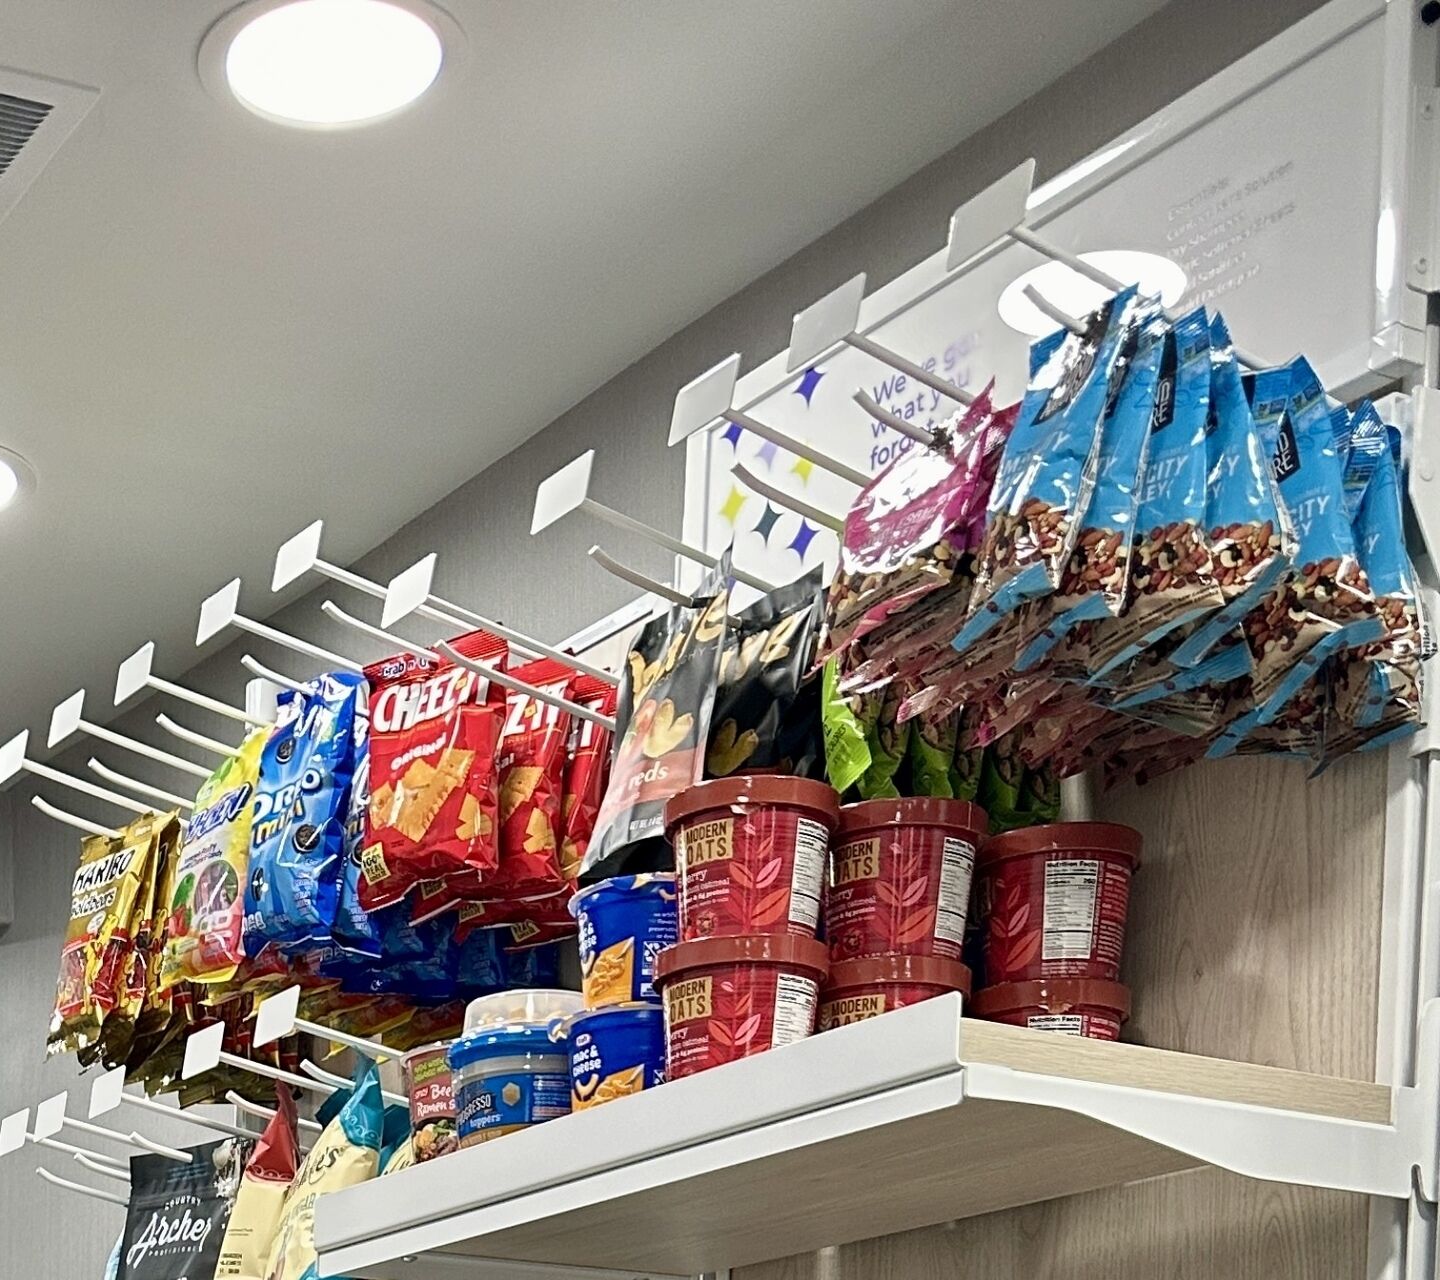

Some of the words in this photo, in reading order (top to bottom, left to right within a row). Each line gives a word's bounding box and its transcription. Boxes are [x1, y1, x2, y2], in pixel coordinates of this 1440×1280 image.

[873, 356, 936, 405] Wee
[870, 417, 935, 471] forgt
[627, 760, 669, 792] reds
[686, 820, 728, 843] MODERN
[687, 837, 728, 866] OATS
[73, 849, 136, 894] HARIBO
[669, 980, 706, 1002] MODERN
[670, 995, 706, 1022] OATS
[831, 997, 878, 1016] MODERN
[573, 1047, 588, 1062] mac
[588, 1045, 598, 1059] &
[572, 1058, 602, 1078] cheese
[416, 1101, 448, 1117] Ramen
[469, 1114, 502, 1129] toppers
[164, 1195, 201, 1211] COUNTRY
[126, 1210, 212, 1270] Archer
